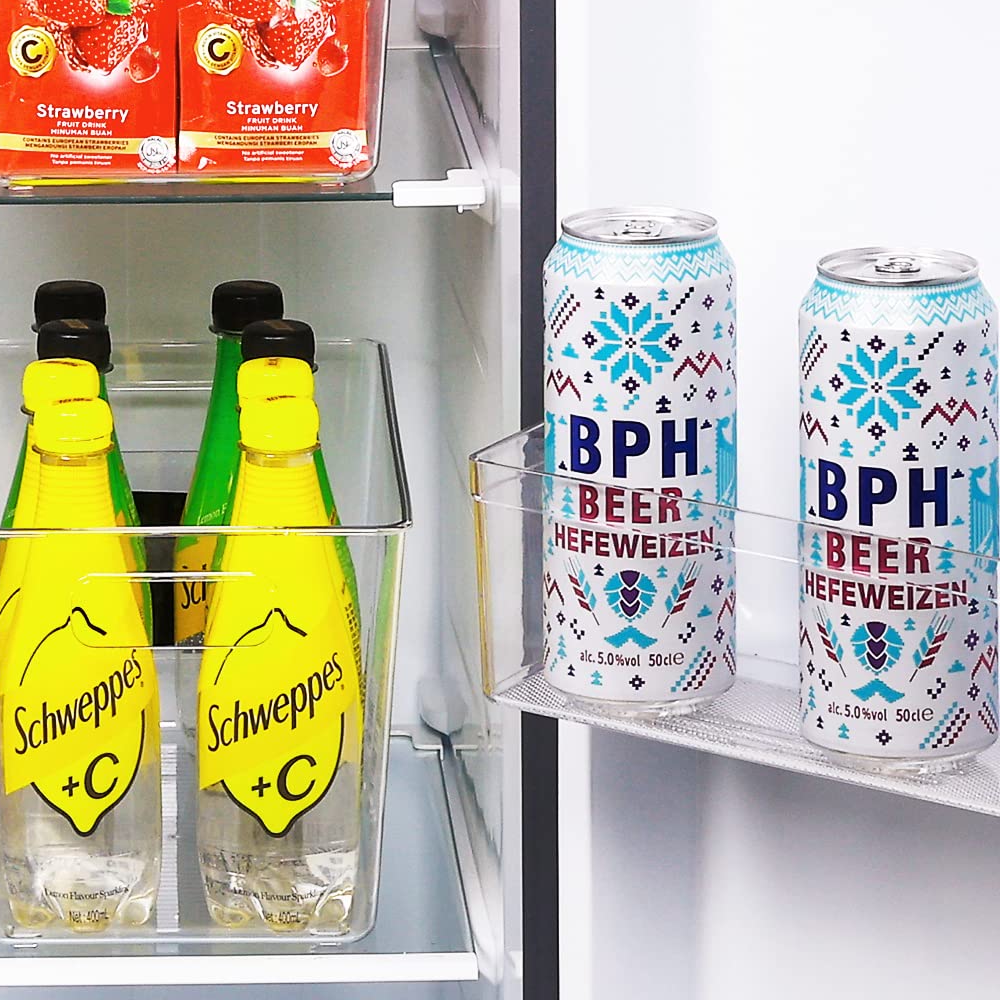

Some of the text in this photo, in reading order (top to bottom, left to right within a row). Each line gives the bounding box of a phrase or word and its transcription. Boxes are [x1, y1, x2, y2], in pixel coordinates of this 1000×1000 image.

[21, 39, 43, 64] C
[208, 37, 230, 62] C
[36, 103, 129, 122] Strawberry
[226, 100, 318, 117] Strawberry
[82, 121, 107, 129] DRINK
[569, 414, 698, 479] BPH
[579, 483, 684, 525] BEER
[817, 459, 949, 529] BPH
[554, 522, 717, 560] HEFEWEIZEN
[825, 531, 932, 576] BEER
[804, 569, 969, 612] HEFEWEIZEN
[580, 650, 595, 663] alc.
[14, 648, 143, 755] Schweppes
[207, 652, 344, 752] Schweppes
[828, 701, 843, 716] alc.
[69, 889, 98, 900] Flavour
[261, 891, 291, 901] Flavour
